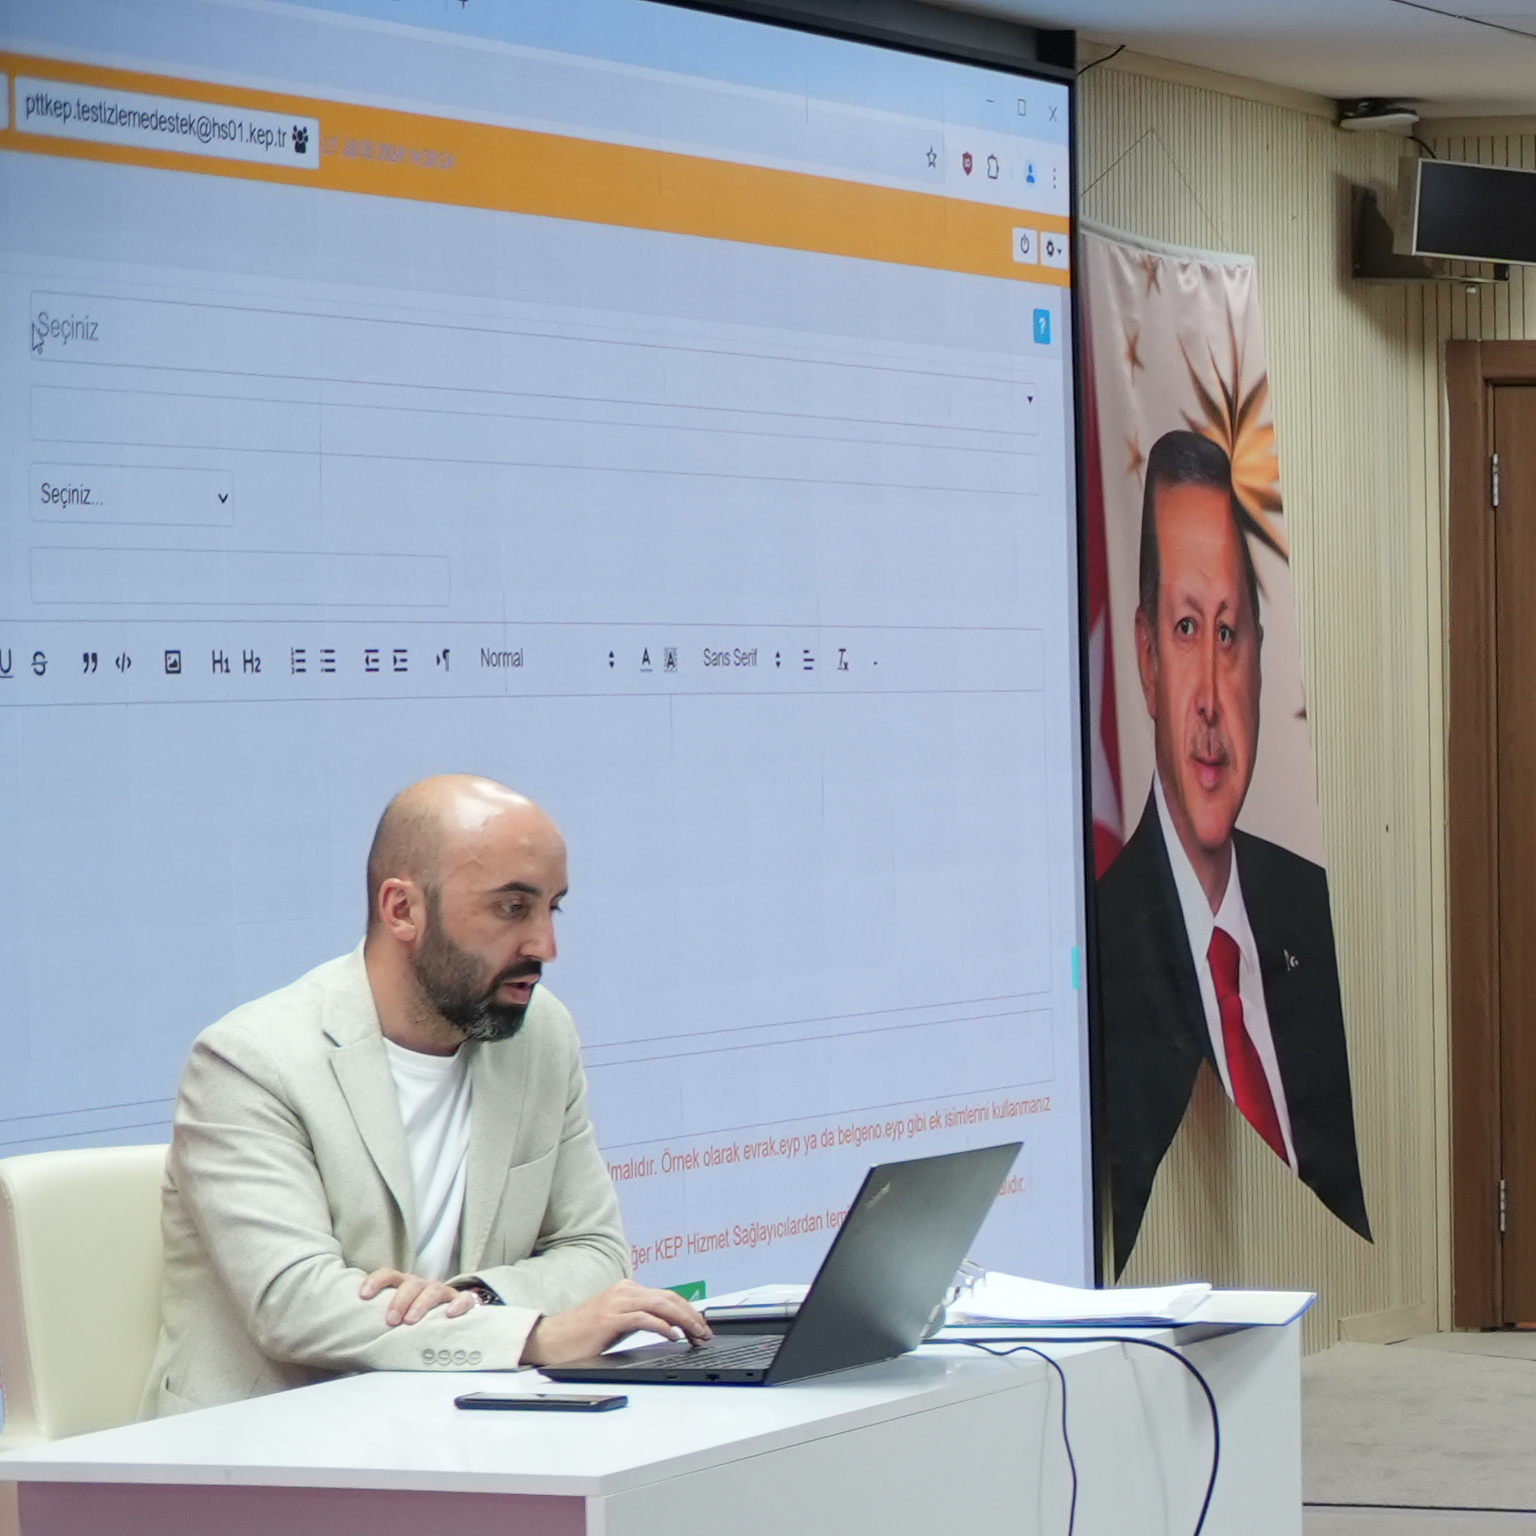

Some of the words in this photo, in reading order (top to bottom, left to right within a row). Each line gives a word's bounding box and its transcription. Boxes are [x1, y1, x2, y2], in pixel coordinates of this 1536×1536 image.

[26, 92, 287, 152] pttkep.testizlemedestek@hs01.kep.tr
[38, 311, 99, 346] Seçiniz
[41, 482, 104, 509] Seçiniz...
[480, 647, 524, 667] Normal
[703, 647, 731, 667] Sans
[733, 647, 758, 667] Serif
[661, 1147, 700, 1173] Örnek
[703, 1141, 740, 1167] olarak
[743, 1136, 800, 1160] evrak.eyp
[803, 1133, 817, 1155] ya
[820, 1126, 835, 1148] da
[838, 1121, 904, 1147] belgeno.eyp
[907, 1112, 926, 1139] gibi
[929, 1110, 942, 1130] ek
[944, 1103, 989, 1128] isimlerini
[630, 1243, 651, 1271] ğer
[655, 1236, 683, 1261] KEP
[687, 1229, 730, 1255] Hizmet
[733, 1212, 823, 1248] Sağlayıcılardan
